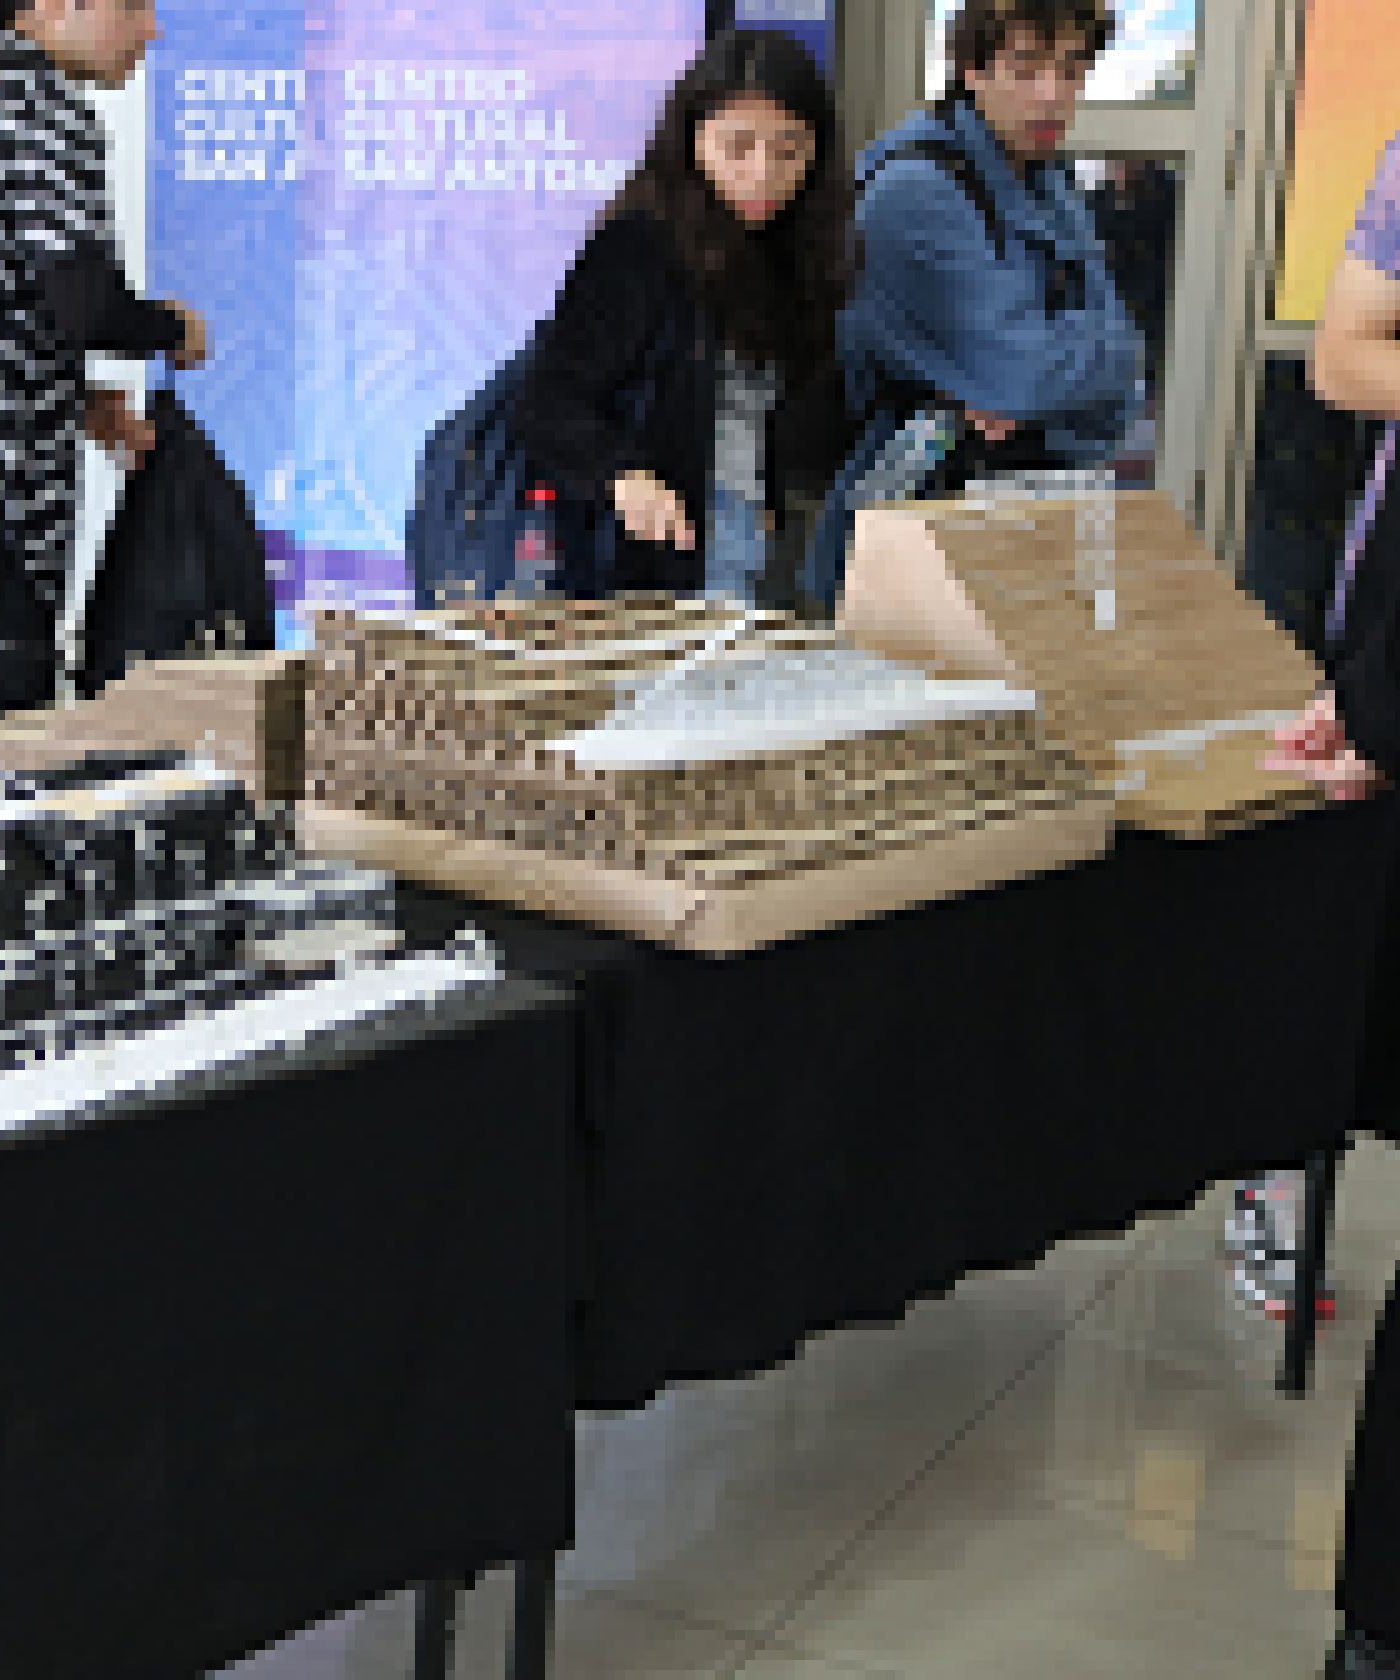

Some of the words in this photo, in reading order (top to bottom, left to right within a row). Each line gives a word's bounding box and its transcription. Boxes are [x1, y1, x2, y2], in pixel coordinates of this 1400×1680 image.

[175, 69, 303, 101] CENT
[340, 67, 532, 101] CENTRO
[175, 109, 303, 140] CULT
[340, 109, 582, 149] CULTURAL
[177, 149, 270, 181] SAN
[340, 151, 436, 188] SAN
